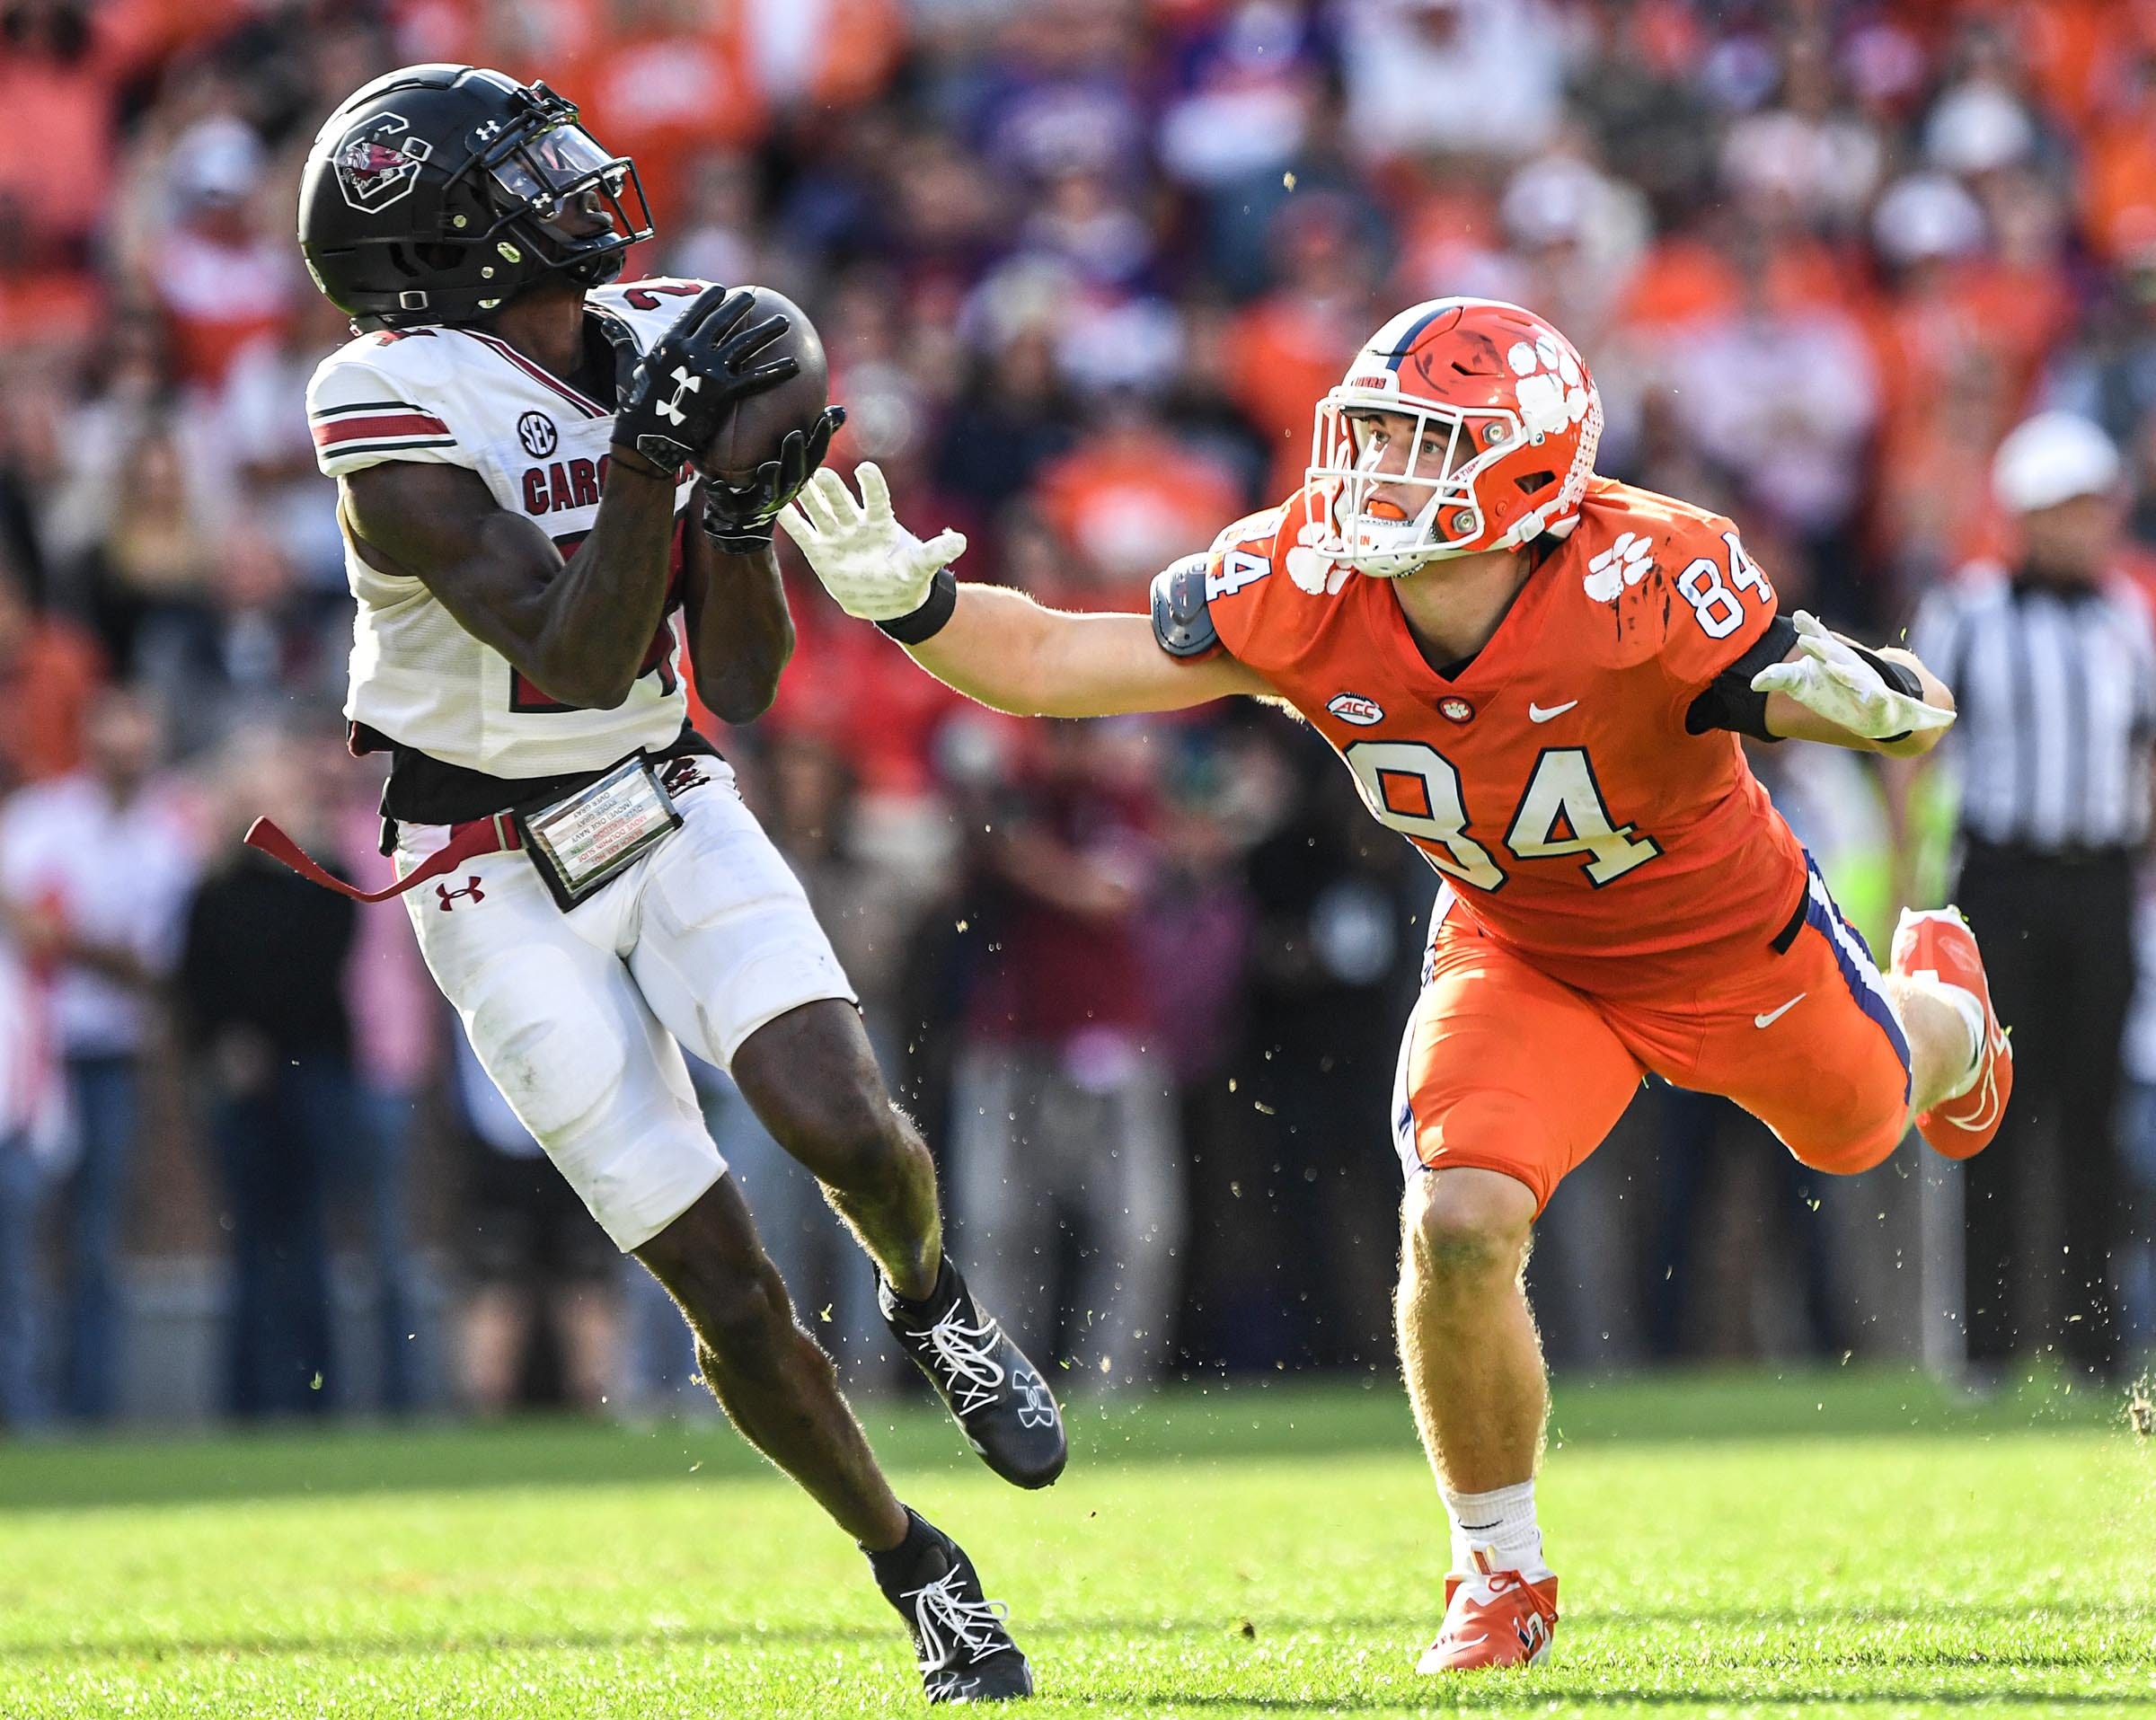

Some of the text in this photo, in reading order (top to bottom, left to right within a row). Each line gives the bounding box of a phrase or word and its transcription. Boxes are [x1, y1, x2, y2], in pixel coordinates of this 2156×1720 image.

[520, 414, 555, 454] SEC
[1675, 531, 1772, 640] 84
[1336, 701, 1376, 718] ACC
[571, 791, 610, 819] OVER GRAY
[574, 813, 595, 828] GRAY
[1342, 738, 1666, 895] 84
[570, 827, 590, 843] NAVY
[577, 814, 647, 862] MOVE DOLPHIN SLIDE
